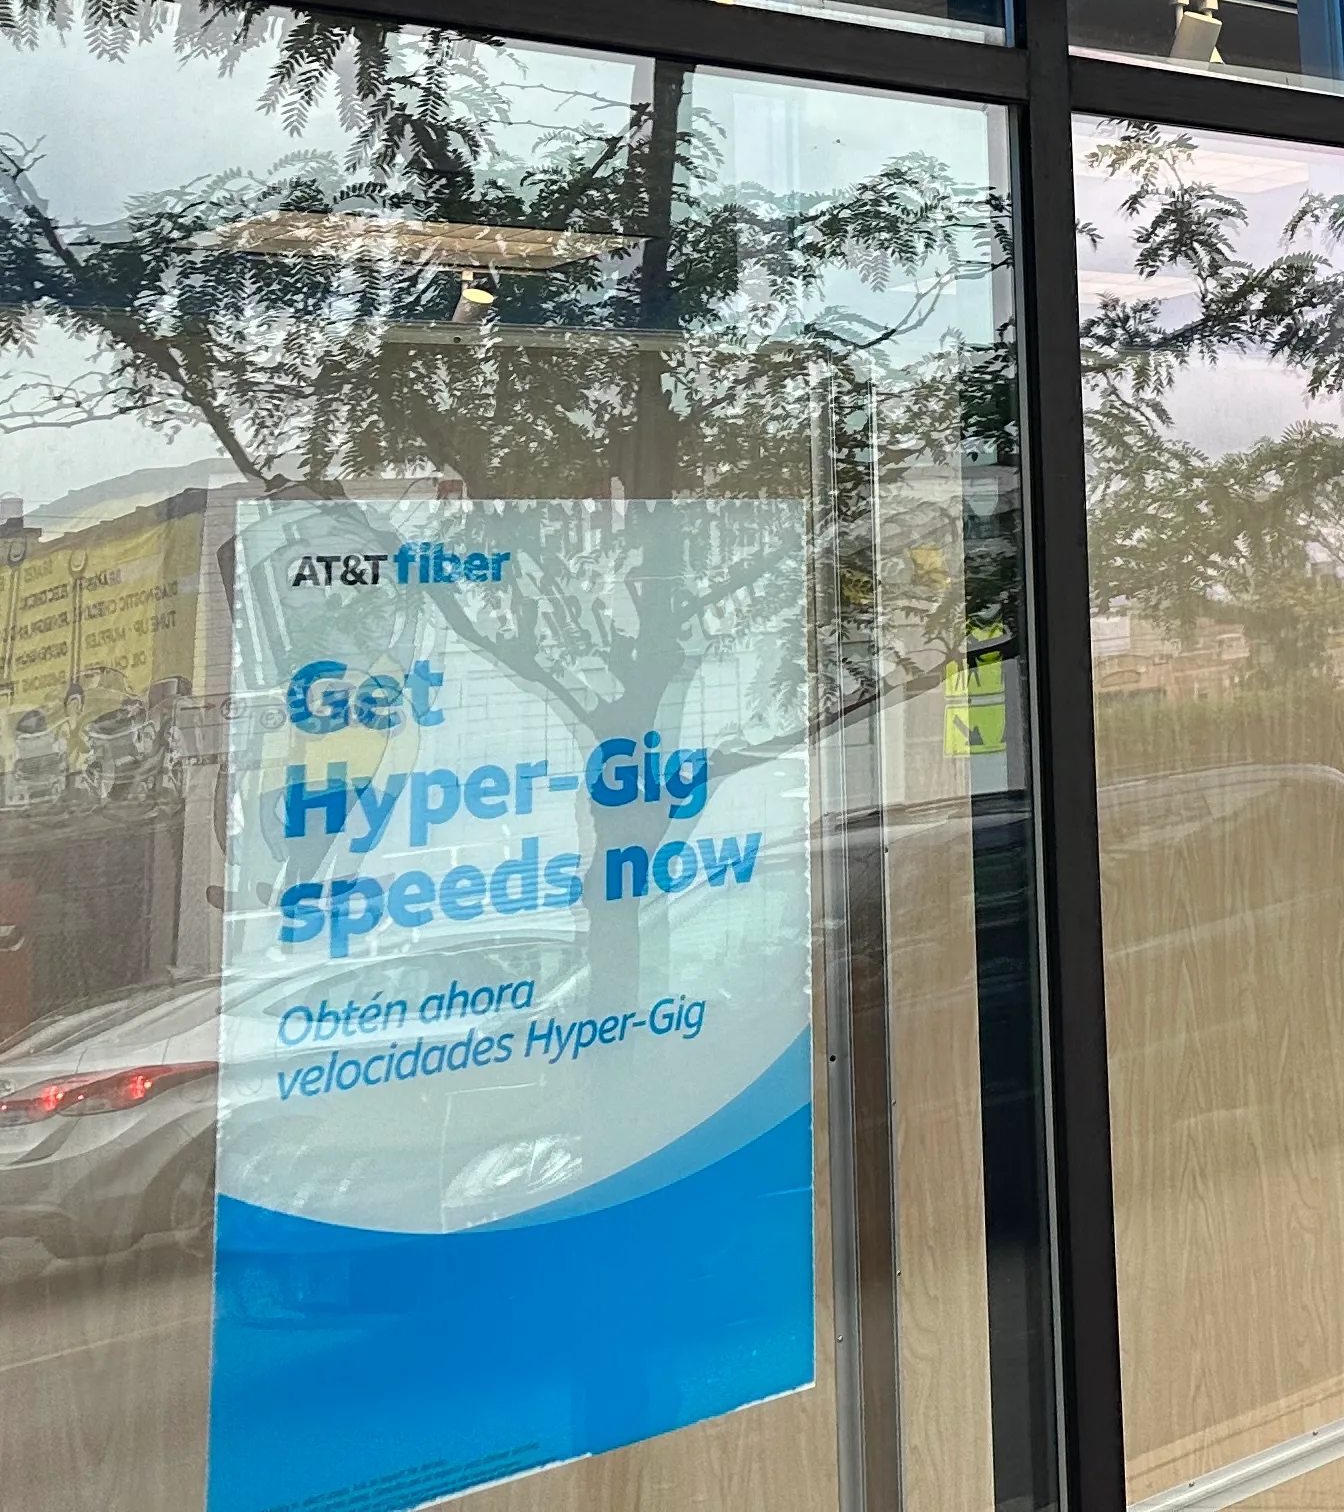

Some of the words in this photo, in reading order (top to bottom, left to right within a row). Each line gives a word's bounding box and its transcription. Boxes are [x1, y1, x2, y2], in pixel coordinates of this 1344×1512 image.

[292, 553, 389, 588] AT&T
[394, 541, 511, 586] fiber
[286, 659, 445, 735] Get
[284, 730, 709, 854] Hyper-Gig
[277, 836, 584, 959] speeds
[605, 831, 763, 902] now
[276, 1026, 514, 1101] velocidades
[525, 995, 707, 1060] Hyper-Gig
[277, 989, 409, 1047] Obtén
[418, 975, 536, 1024] ahora
